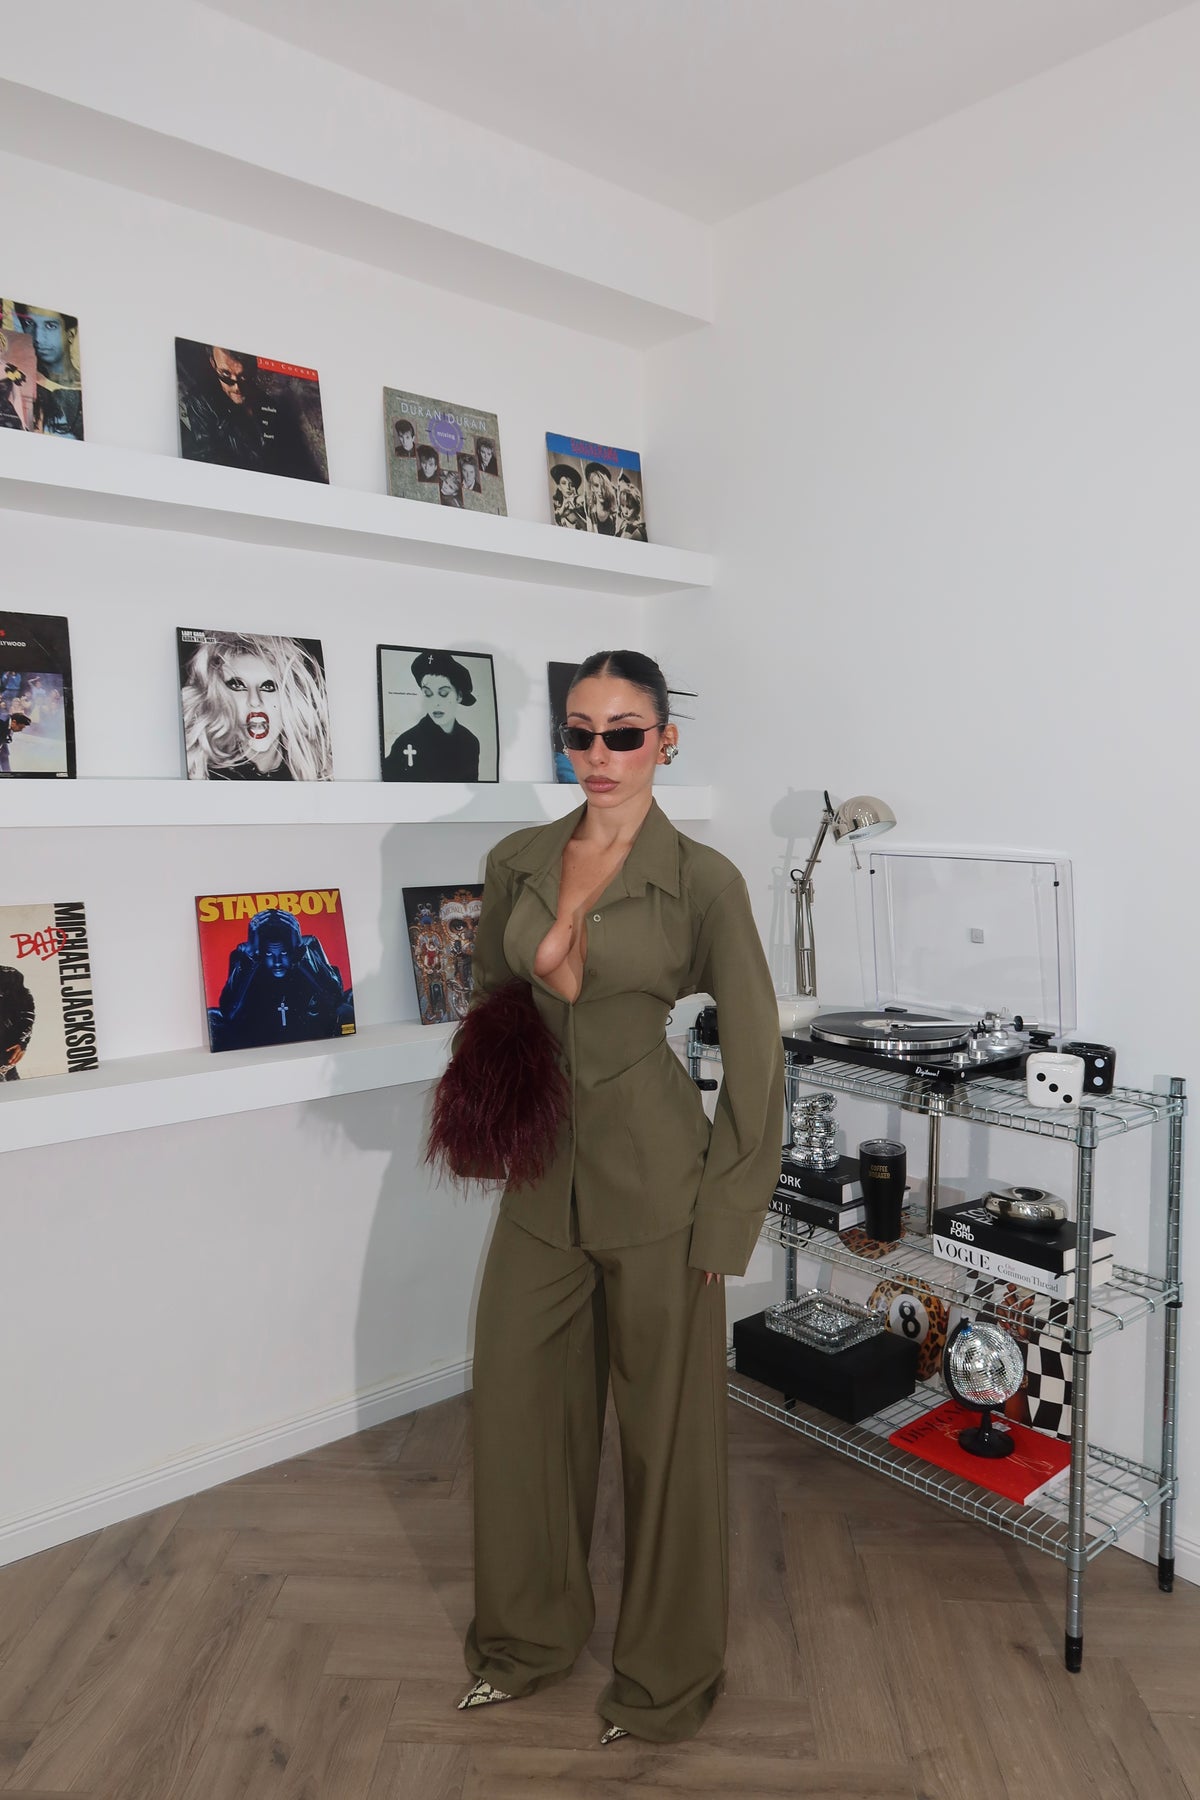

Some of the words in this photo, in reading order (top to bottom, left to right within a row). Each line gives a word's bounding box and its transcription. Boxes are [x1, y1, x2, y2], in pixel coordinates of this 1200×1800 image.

[401, 402, 441, 420] DURAN
[447, 413, 486, 431] DURAN
[199, 891, 339, 922] STARBOY
[10, 926, 67, 961] BAD
[54, 902, 91, 986] MICHAEL
[61, 986, 99, 1073] JACKSON
[780, 1173, 801, 1189] ORK
[768, 1199, 792, 1215] OGUE
[950, 1219, 971, 1233] TOM
[950, 1227, 975, 1241] FORD
[937, 1239, 990, 1270] VOGUE
[997, 1265, 1031, 1283] Common
[1032, 1276, 1059, 1293] Thread
[899, 1301, 921, 1338] 8
